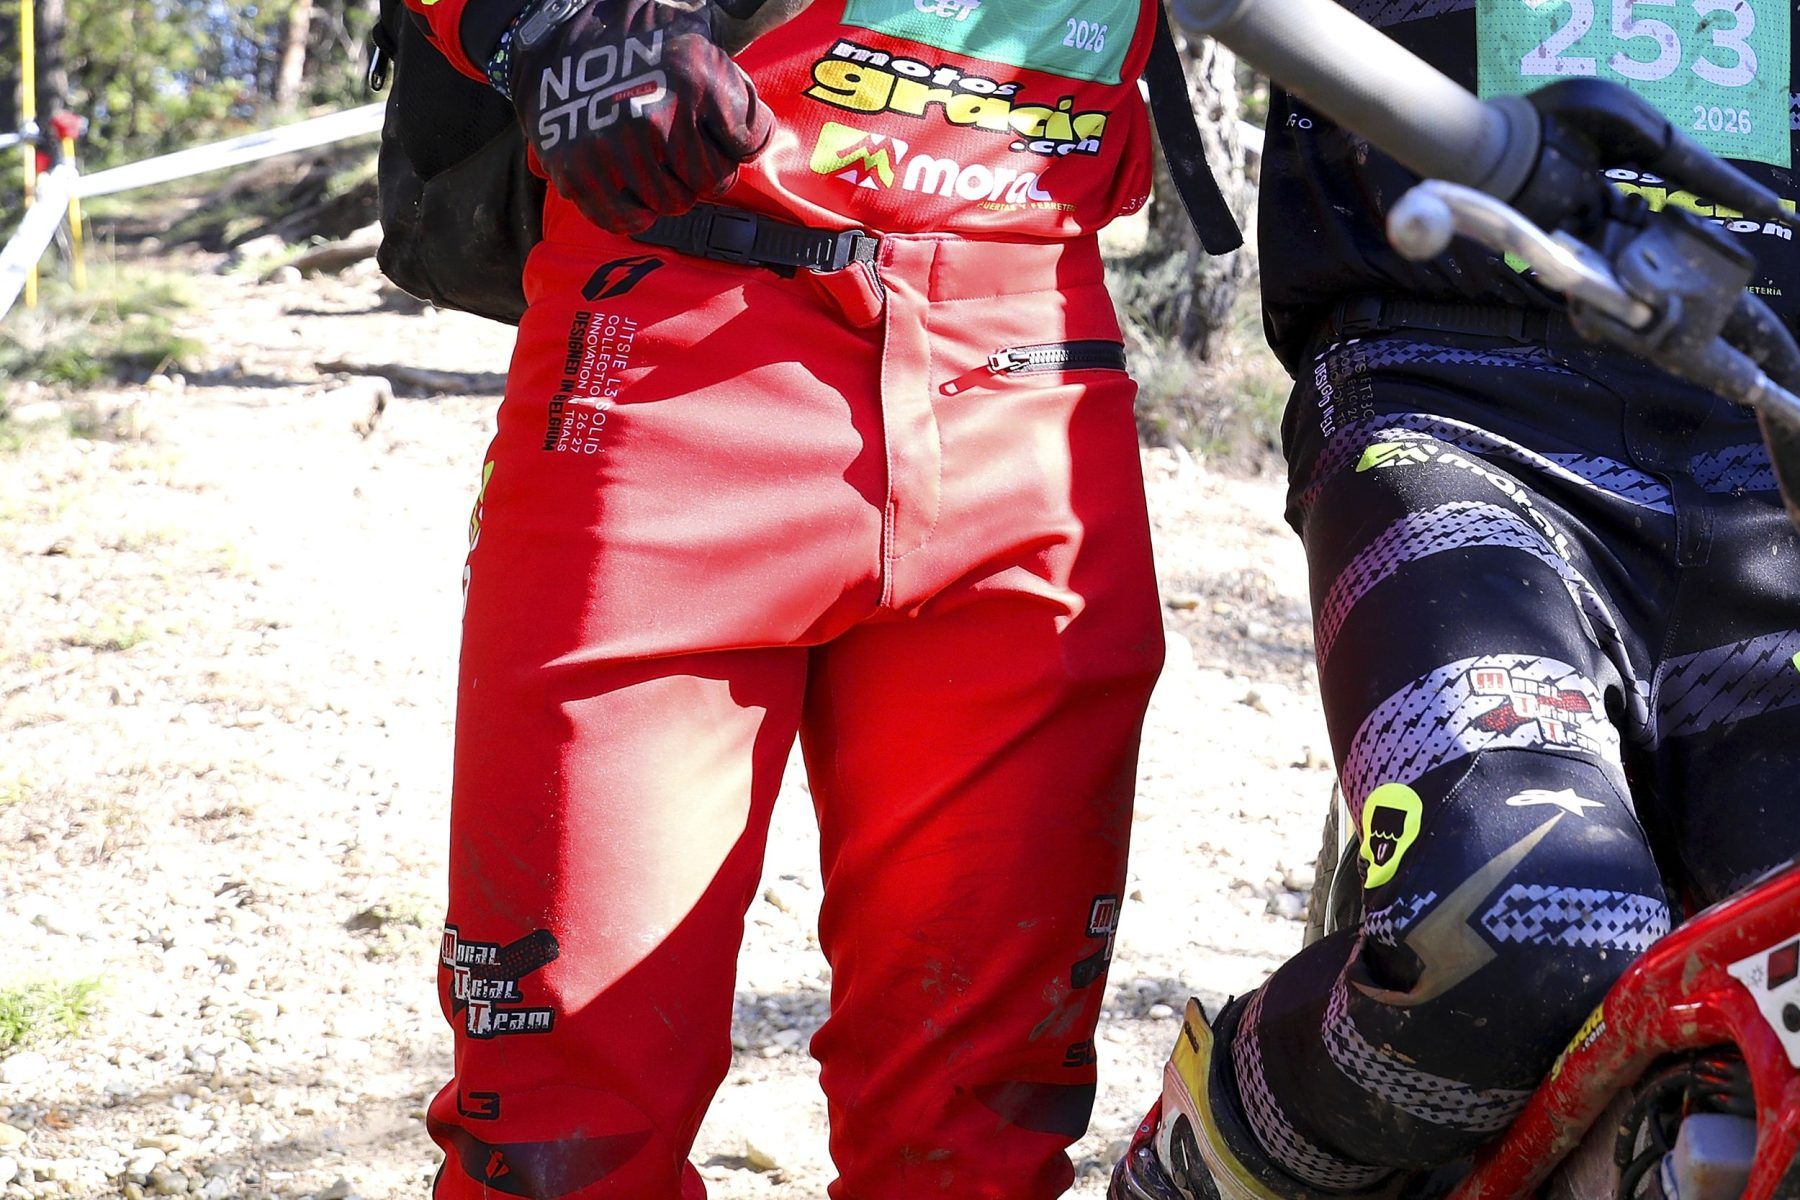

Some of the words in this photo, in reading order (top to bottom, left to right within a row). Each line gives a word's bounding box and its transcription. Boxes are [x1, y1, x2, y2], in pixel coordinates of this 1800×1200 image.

[1061, 17, 1110, 53] 2026
[538, 28, 665, 112] NON
[830, 42, 1016, 96] motos
[537, 67, 669, 151] STOP
[806, 60, 1108, 141] gracia
[1692, 104, 1753, 135] 2026
[563, 311, 591, 376] DESIGNED
[577, 312, 606, 390] INNOVATION
[588, 314, 620, 402] COLLECTIO
[611, 317, 638, 370] JITSIE
[560, 379, 576, 393] IN
[603, 378, 621, 398] L3
[542, 394, 568, 452] BELGIUM
[557, 410, 575, 452] TRIALS
[570, 412, 589, 454] 26-27
[584, 401, 612, 455] SOLID
